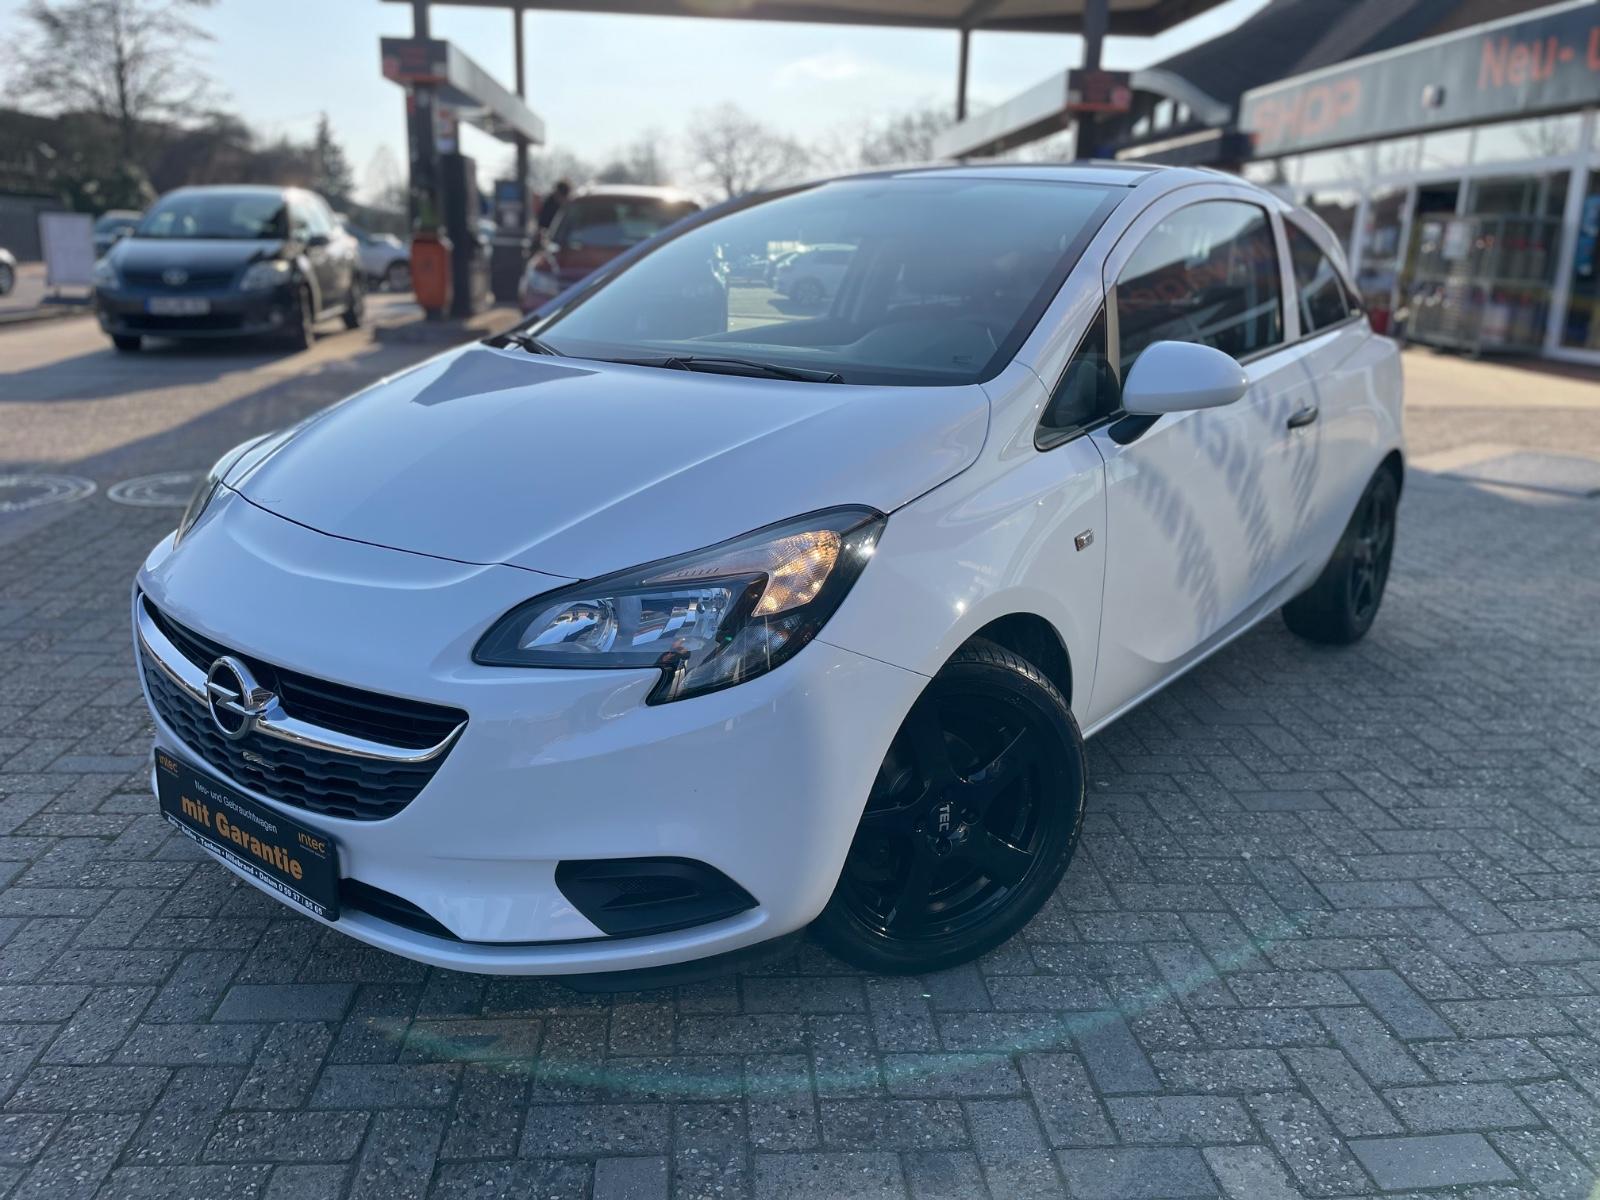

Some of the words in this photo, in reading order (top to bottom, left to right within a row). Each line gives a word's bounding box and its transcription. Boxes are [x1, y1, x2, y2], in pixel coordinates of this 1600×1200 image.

[223, 796, 278, 834] Gebrauchtwagen
[939, 804, 950, 832] TEC
[181, 795, 211, 828] mit
[215, 812, 303, 880] Garantie
